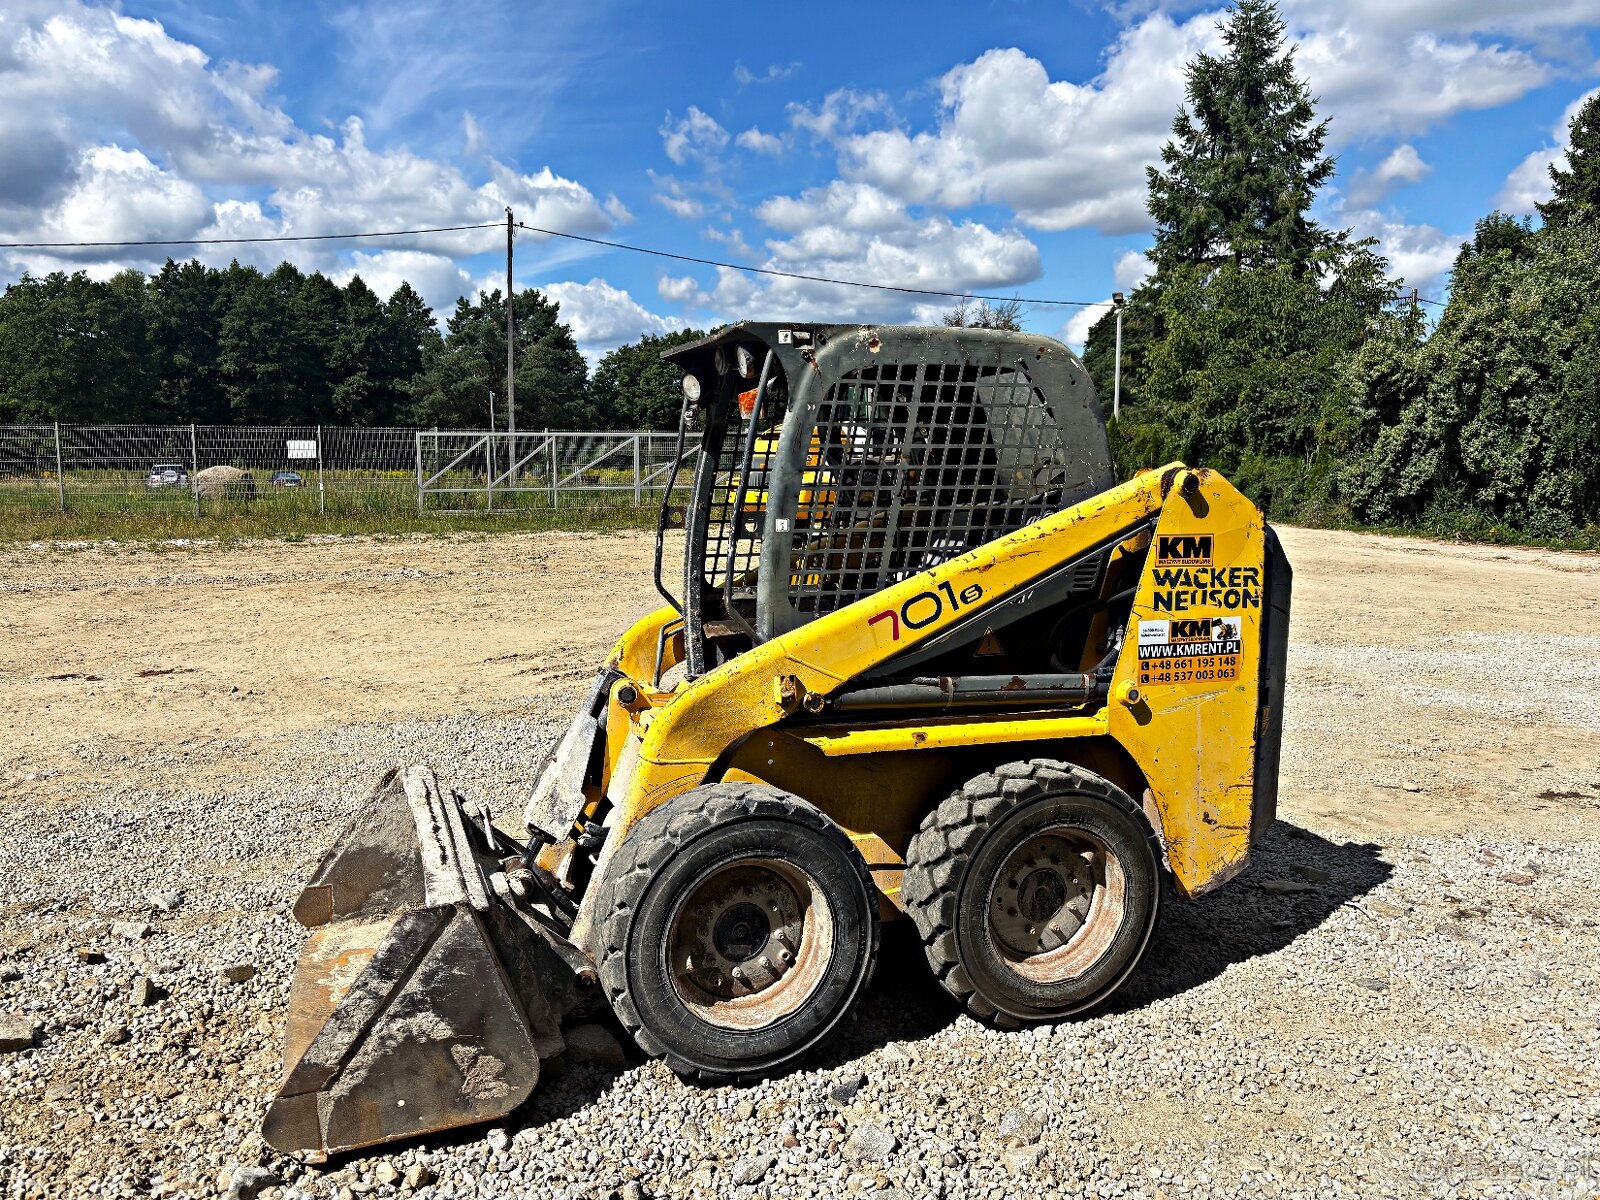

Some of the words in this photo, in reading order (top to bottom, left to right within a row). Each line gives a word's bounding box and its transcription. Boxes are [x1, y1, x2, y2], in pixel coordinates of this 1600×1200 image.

[1158, 536, 1212, 559] KM
[1152, 567, 1261, 589] WACKER
[1153, 589, 1260, 612] NEUSON
[1171, 619, 1211, 637] KM
[1139, 641, 1240, 658] WWW.KMRENT.PL
[1151, 660, 1171, 671] +48
[1174, 659, 1193, 669] 661
[1197, 658, 1215, 668] 195
[1218, 656, 1236, 666] 148
[1151, 672, 1171, 682] +48
[1174, 671, 1193, 681] 537
[1195, 670, 1214, 680] 003
[1217, 668, 1236, 678] 063
